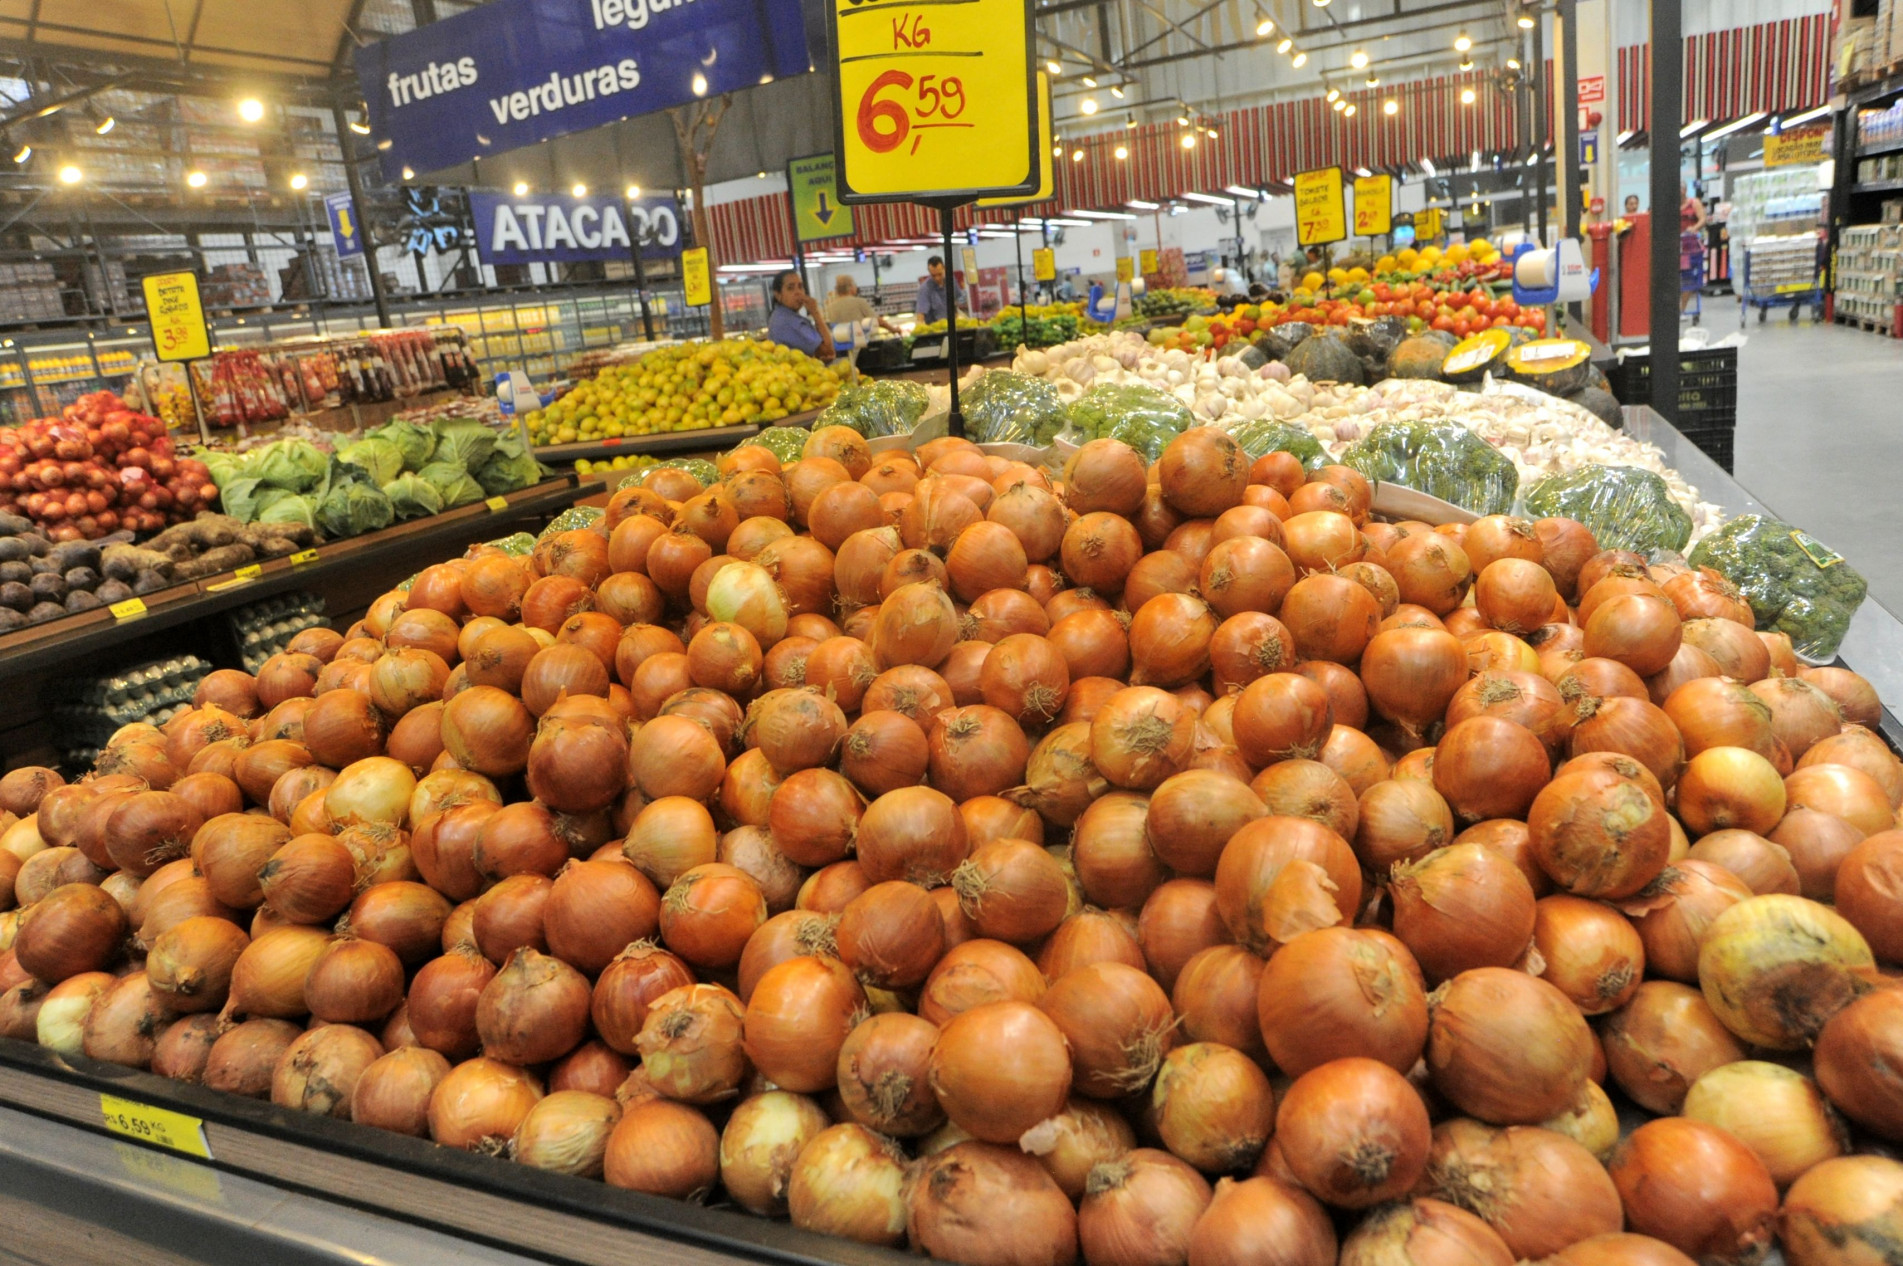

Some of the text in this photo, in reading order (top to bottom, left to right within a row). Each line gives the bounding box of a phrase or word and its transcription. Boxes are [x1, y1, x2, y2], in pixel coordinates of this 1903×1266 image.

[892, 13, 931, 50] KG
[388, 57, 478, 107] frutas
[489, 58, 641, 125] verduras
[808, 175, 832, 185] AQUI
